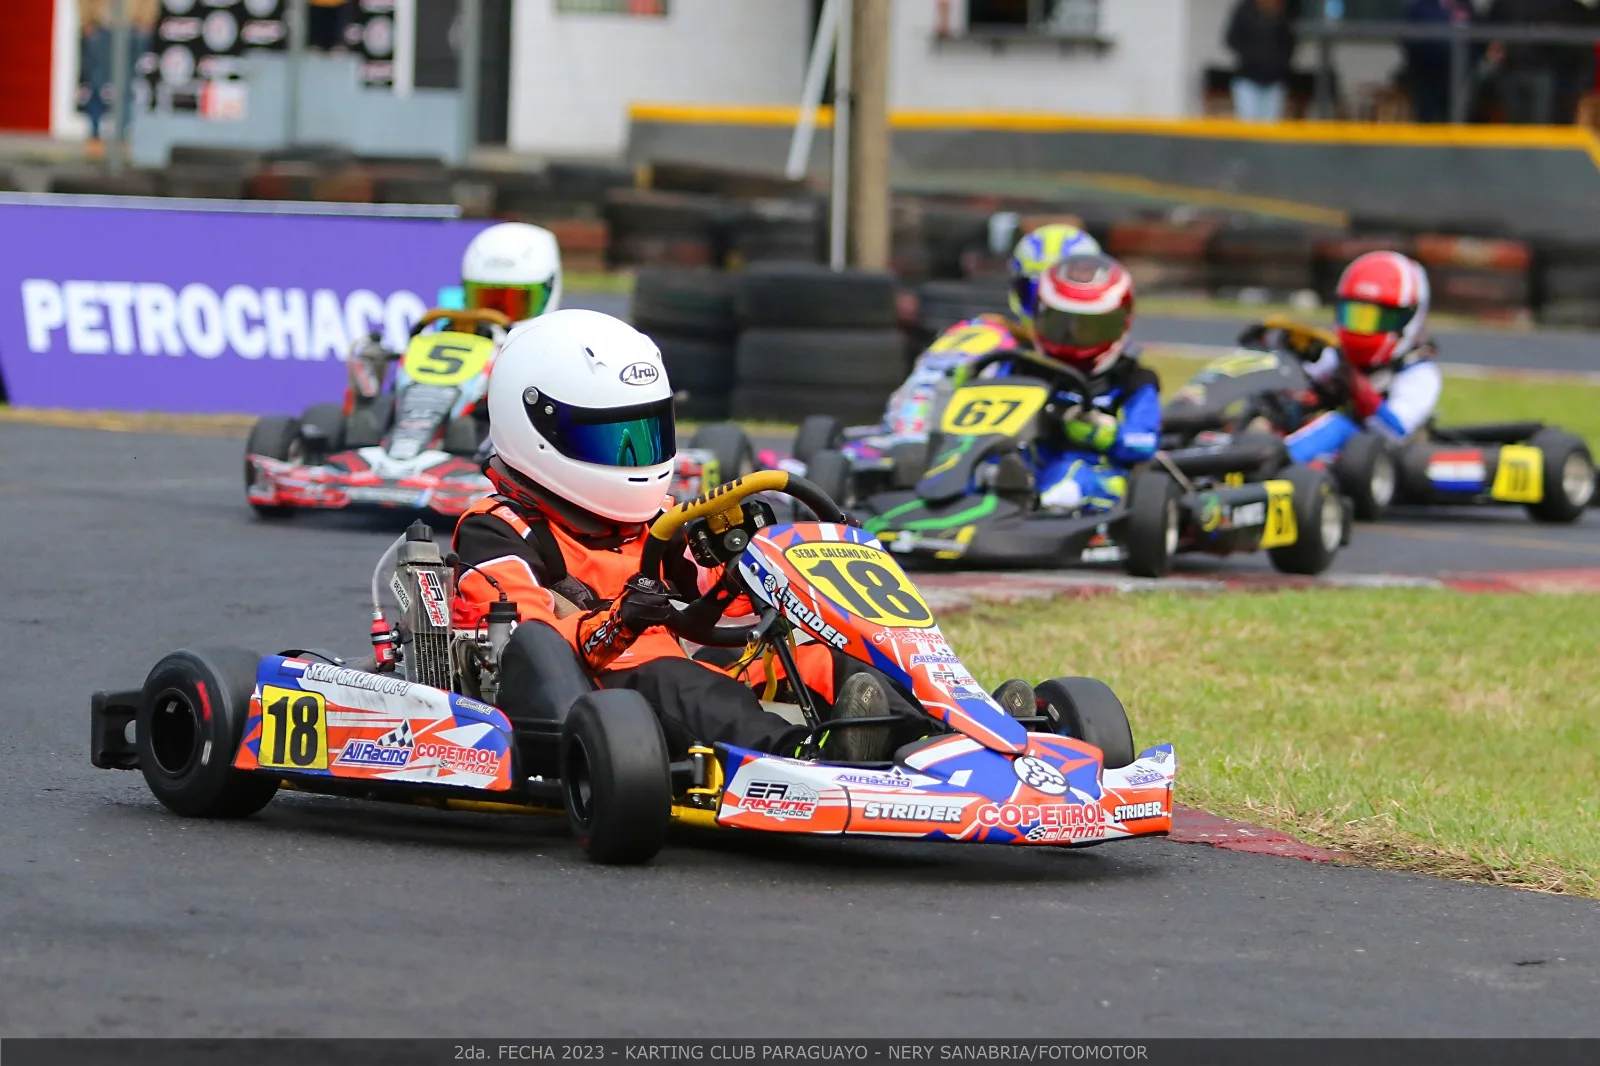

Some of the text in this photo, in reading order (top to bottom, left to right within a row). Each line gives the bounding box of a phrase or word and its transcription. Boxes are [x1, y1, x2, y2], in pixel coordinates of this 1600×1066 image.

[417, 345, 472, 375] 5
[624, 364, 656, 381] Arai
[953, 400, 1024, 427] 67
[792, 548, 819, 559] SEBA
[820, 548, 861, 559] GALEANO
[806, 559, 930, 621] 18
[775, 587, 849, 650] STRIDER
[267, 695, 318, 766] 18
[416, 743, 499, 765] COPETROL
[741, 798, 815, 811] RACING
[766, 809, 809, 817] SCHOOL
[864, 803, 961, 822] STRIDER
[977, 803, 1106, 827] COPETROL
[1114, 801, 1163, 823] STRIDER
